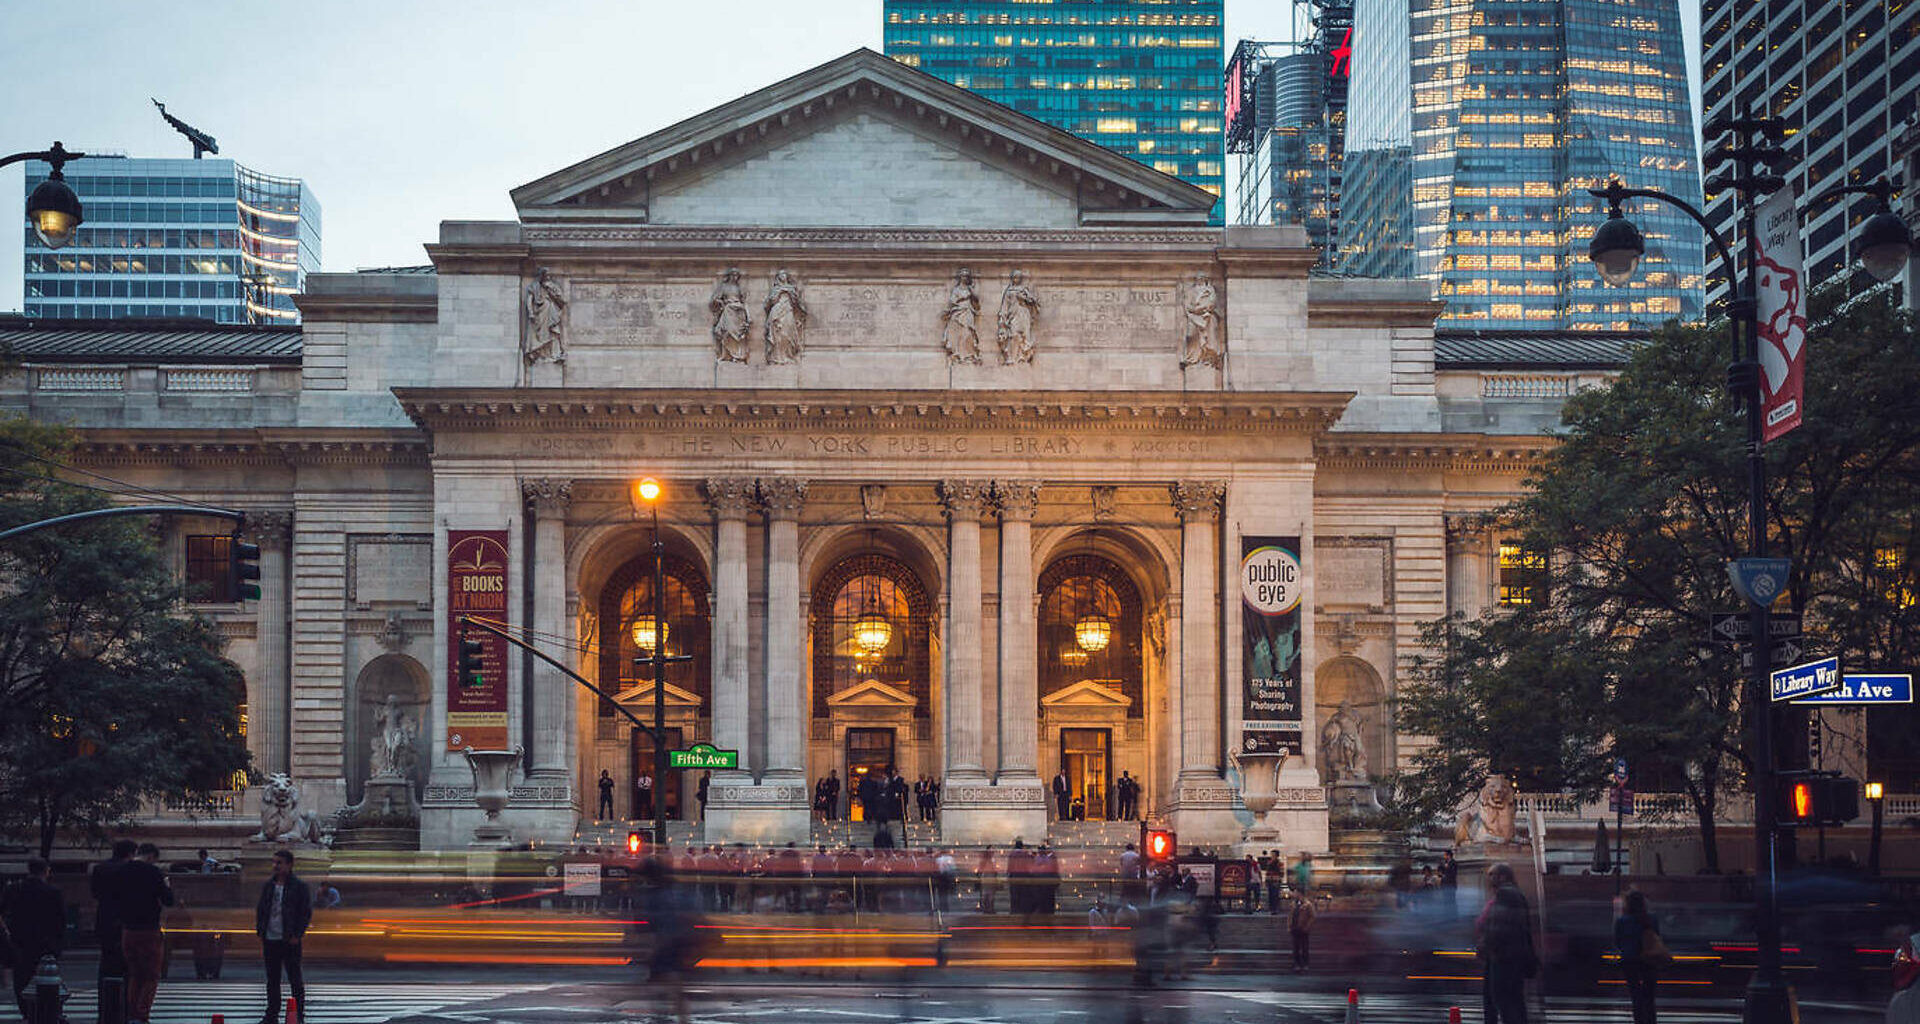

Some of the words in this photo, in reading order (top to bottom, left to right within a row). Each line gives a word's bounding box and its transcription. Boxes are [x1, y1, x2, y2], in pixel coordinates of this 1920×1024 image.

[1767, 207, 1795, 231] Library
[664, 436, 713, 452] THE
[731, 436, 788, 451] NEW
[809, 437, 869, 453] YORK
[887, 437, 969, 453] PUBLIC
[990, 437, 1085, 454] LIBRARY
[1249, 558, 1295, 585] public
[462, 575, 503, 592] BOOKS
[453, 593, 467, 608] AT
[470, 593, 504, 609] NOON
[1258, 584, 1286, 605] eye
[1265, 678, 1284, 688] Years
[1782, 675, 1814, 693] Library
[1816, 667, 1837, 687] Way
[1258, 689, 1286, 700] Sharing
[1857, 681, 1893, 698] Ave
[1250, 700, 1294, 711] Photography
[677, 753, 704, 765] Fifth
[706, 754, 729, 765] Ave
